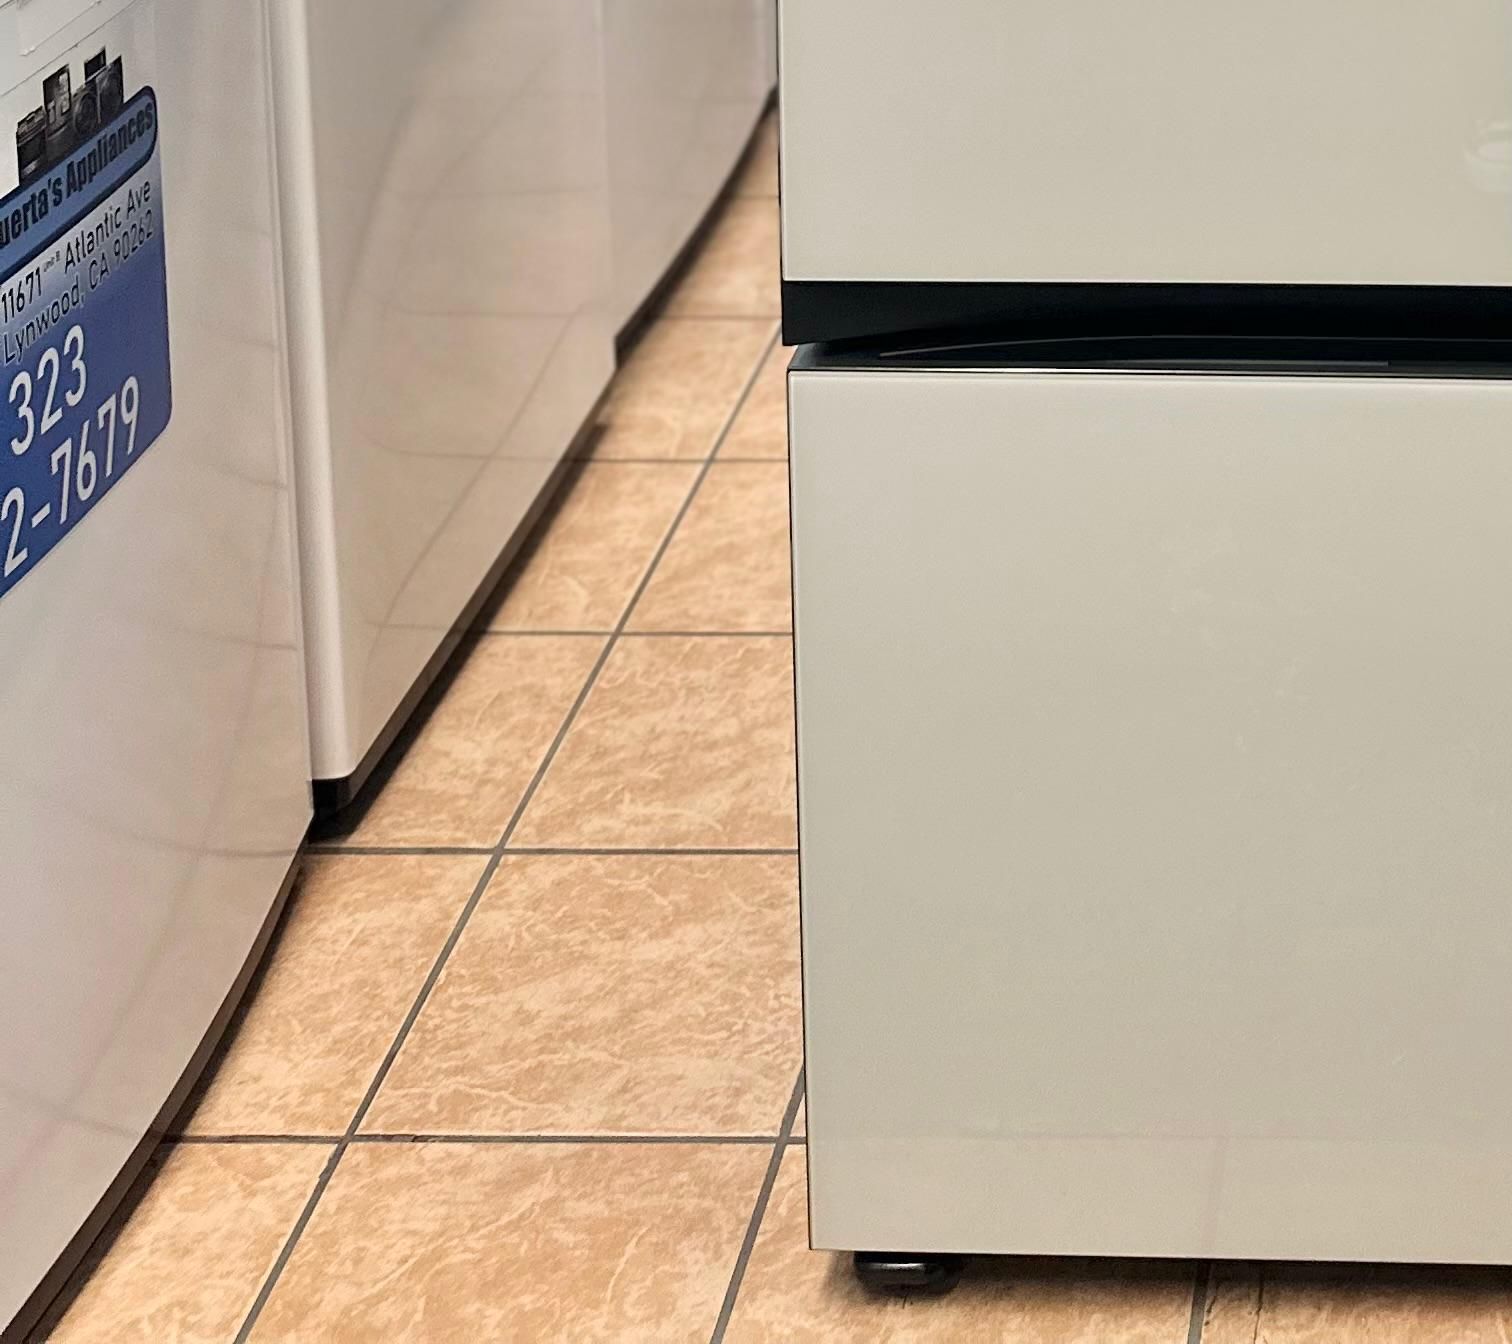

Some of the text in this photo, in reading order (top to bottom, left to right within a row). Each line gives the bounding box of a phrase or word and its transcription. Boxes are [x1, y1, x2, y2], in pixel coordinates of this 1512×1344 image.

[66, 103, 153, 199] Appliances
[2, 266, 41, 323] 11671
[65, 207, 121, 274] Atlantic
[127, 181, 150, 219] Ave
[3, 209, 152, 363] Lynwood, CA 90262
[8, 325, 87, 455] 323
[1, 376, 139, 577] 2-7679
